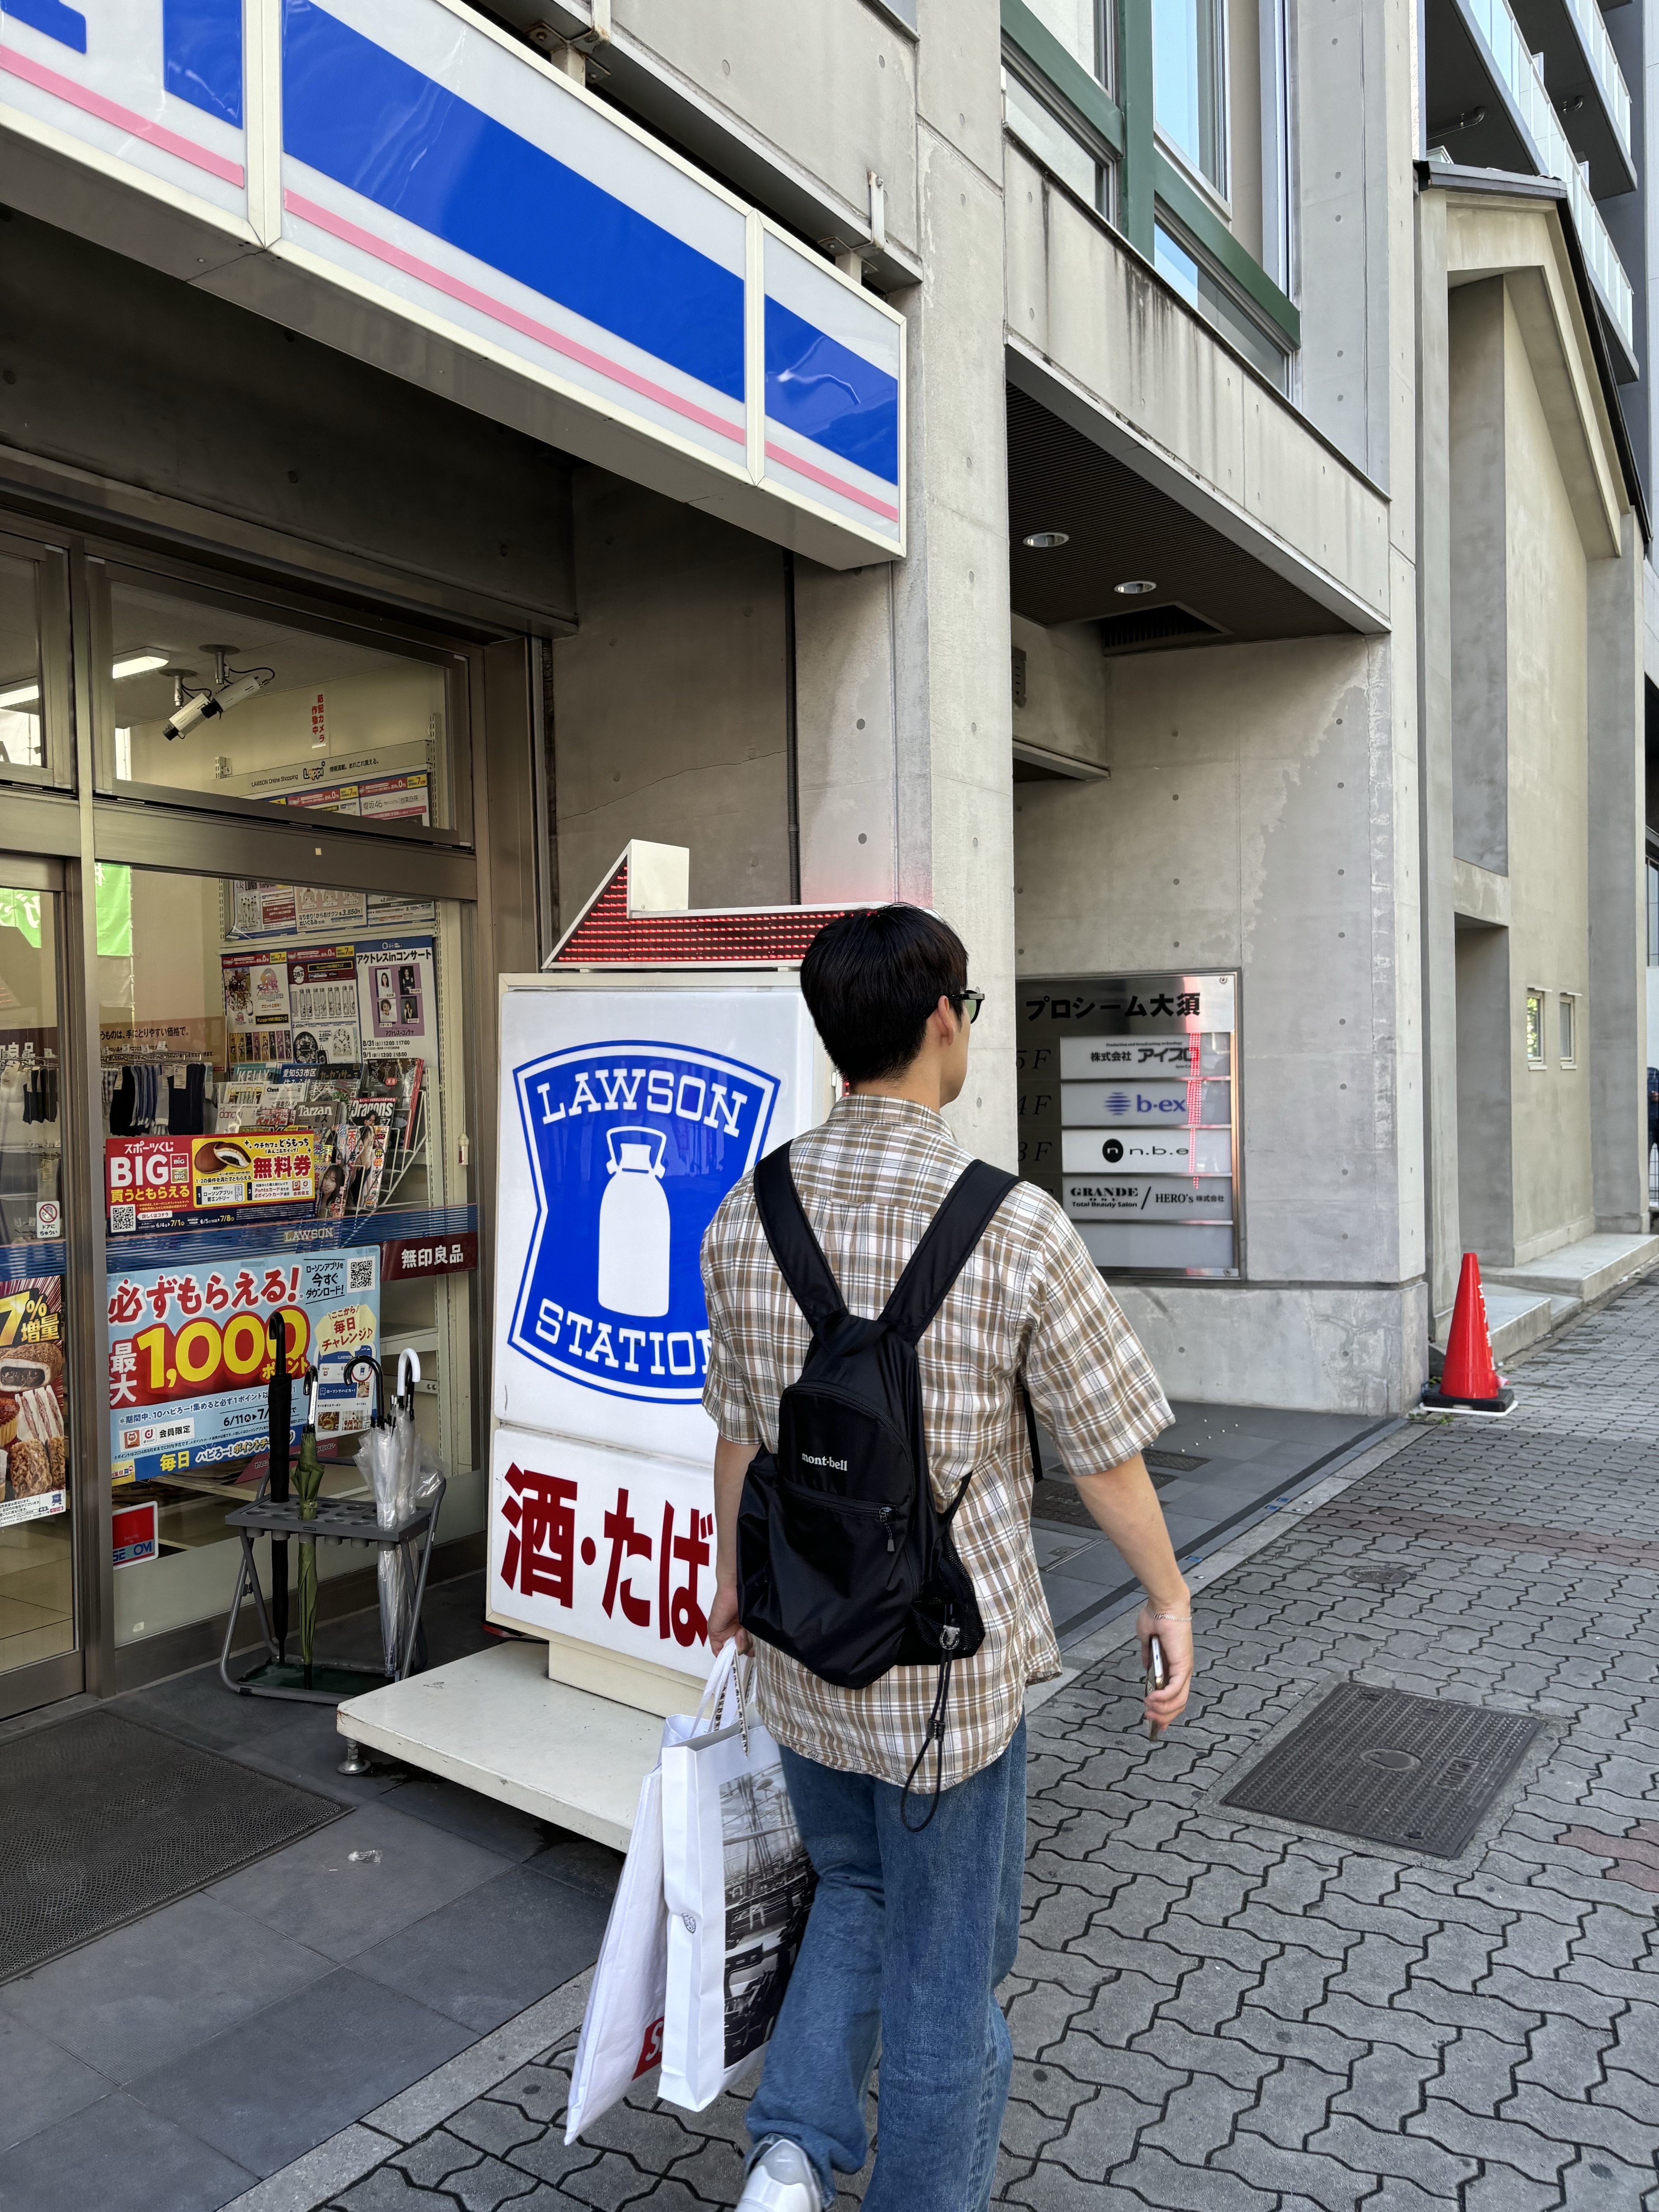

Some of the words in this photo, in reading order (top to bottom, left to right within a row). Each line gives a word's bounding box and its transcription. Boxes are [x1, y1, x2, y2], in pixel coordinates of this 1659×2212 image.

[303, 761, 325, 780] Loppi
[357, 949, 431, 964] アクトレスinコンサート
[1026, 992, 1201, 1021] プロシーム大須
[1091, 1051, 1132, 1063] 株式会社
[283, 1068, 317, 1078] 愛知53市区
[298, 1104, 333, 1116] Tarzan
[351, 1100, 393, 1118] Dragons
[537, 1068, 748, 1138] LAWSON
[124, 1140, 174, 1154] スポーツくじ
[279, 1138, 309, 1147] どらもっち
[110, 1154, 169, 1187] BIG
[253, 1154, 311, 1179] 無料券
[111, 1185, 190, 1203] 買うともらえる
[1070, 1187, 1138, 1196] GRANDE
[1156, 1193, 1194, 1203] HERO's
[284, 1227, 333, 1242] LAWSON
[401, 1243, 464, 1269] 無印良品
[306, 1261, 344, 1273] ローソンアプリを
[312, 1273, 338, 1287] 今すぐ
[108, 1267, 301, 1324] 必ずもらえる!
[306, 1285, 344, 1299] ダウンロード!
[331, 1305, 356, 1319] ここから
[21, 1313, 60, 1343] 増量
[333, 1317, 356, 1334] 毎日
[137, 1309, 307, 1389] 1,000
[110, 1341, 137, 1407] 最大
[262, 1357, 309, 1379] ポント
[159, 1425, 191, 1438] 会員限定
[160, 1450, 189, 1472] 毎日
